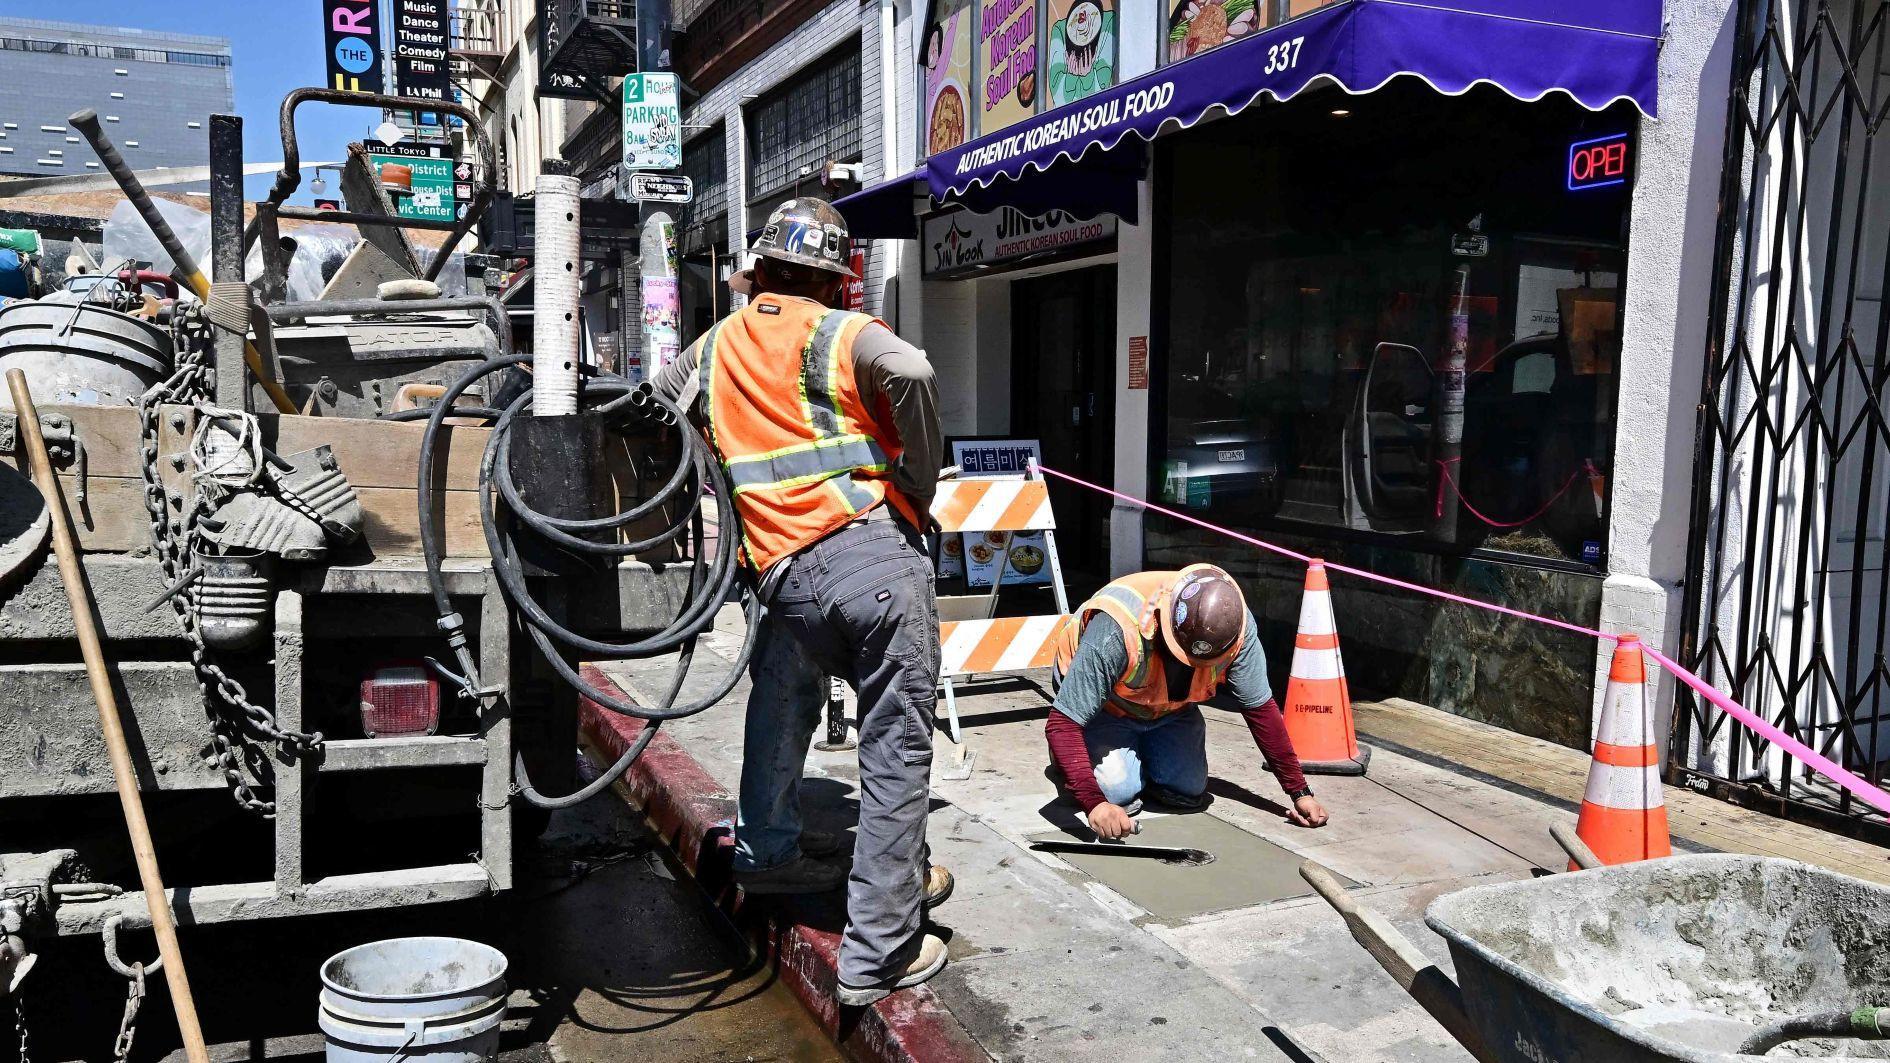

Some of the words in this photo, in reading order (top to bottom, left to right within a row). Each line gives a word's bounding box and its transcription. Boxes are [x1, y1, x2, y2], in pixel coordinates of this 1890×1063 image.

[404, 1, 437, 13] Music
[403, 16, 439, 28] Dance
[399, 30, 444, 43] Theater
[991, 6, 1034, 72] Korean
[340, 49, 368, 61] THE
[399, 45, 446, 60] Comedy
[1264, 37, 1304, 75] 337
[411, 60, 435, 72] Film
[986, 54, 1012, 112] Soul
[1012, 44, 1035, 89] Foo
[406, 86, 420, 97] LA
[421, 88, 442, 98] Phil
[628, 79, 639, 99] 2
[955, 133, 1027, 175] AUTHENTIC
[1023, 112, 1081, 154] KOREAN
[1080, 99, 1121, 134] SOUL
[1122, 82, 1175, 121] FOOD
[367, 145, 396, 154] LITTLE
[398, 147, 426, 156] TOKYO
[407, 163, 447, 176] District
[436, 185, 453, 196] Dist
[417, 205, 452, 216] Center
[994, 238, 1030, 258] AUTHENTIC
[1030, 232, 1059, 251] KOREAN
[1060, 228, 1079, 243] SOUL
[1080, 223, 1103, 240] FOOD
[1305, 704, 1334, 714] PIPELINE
